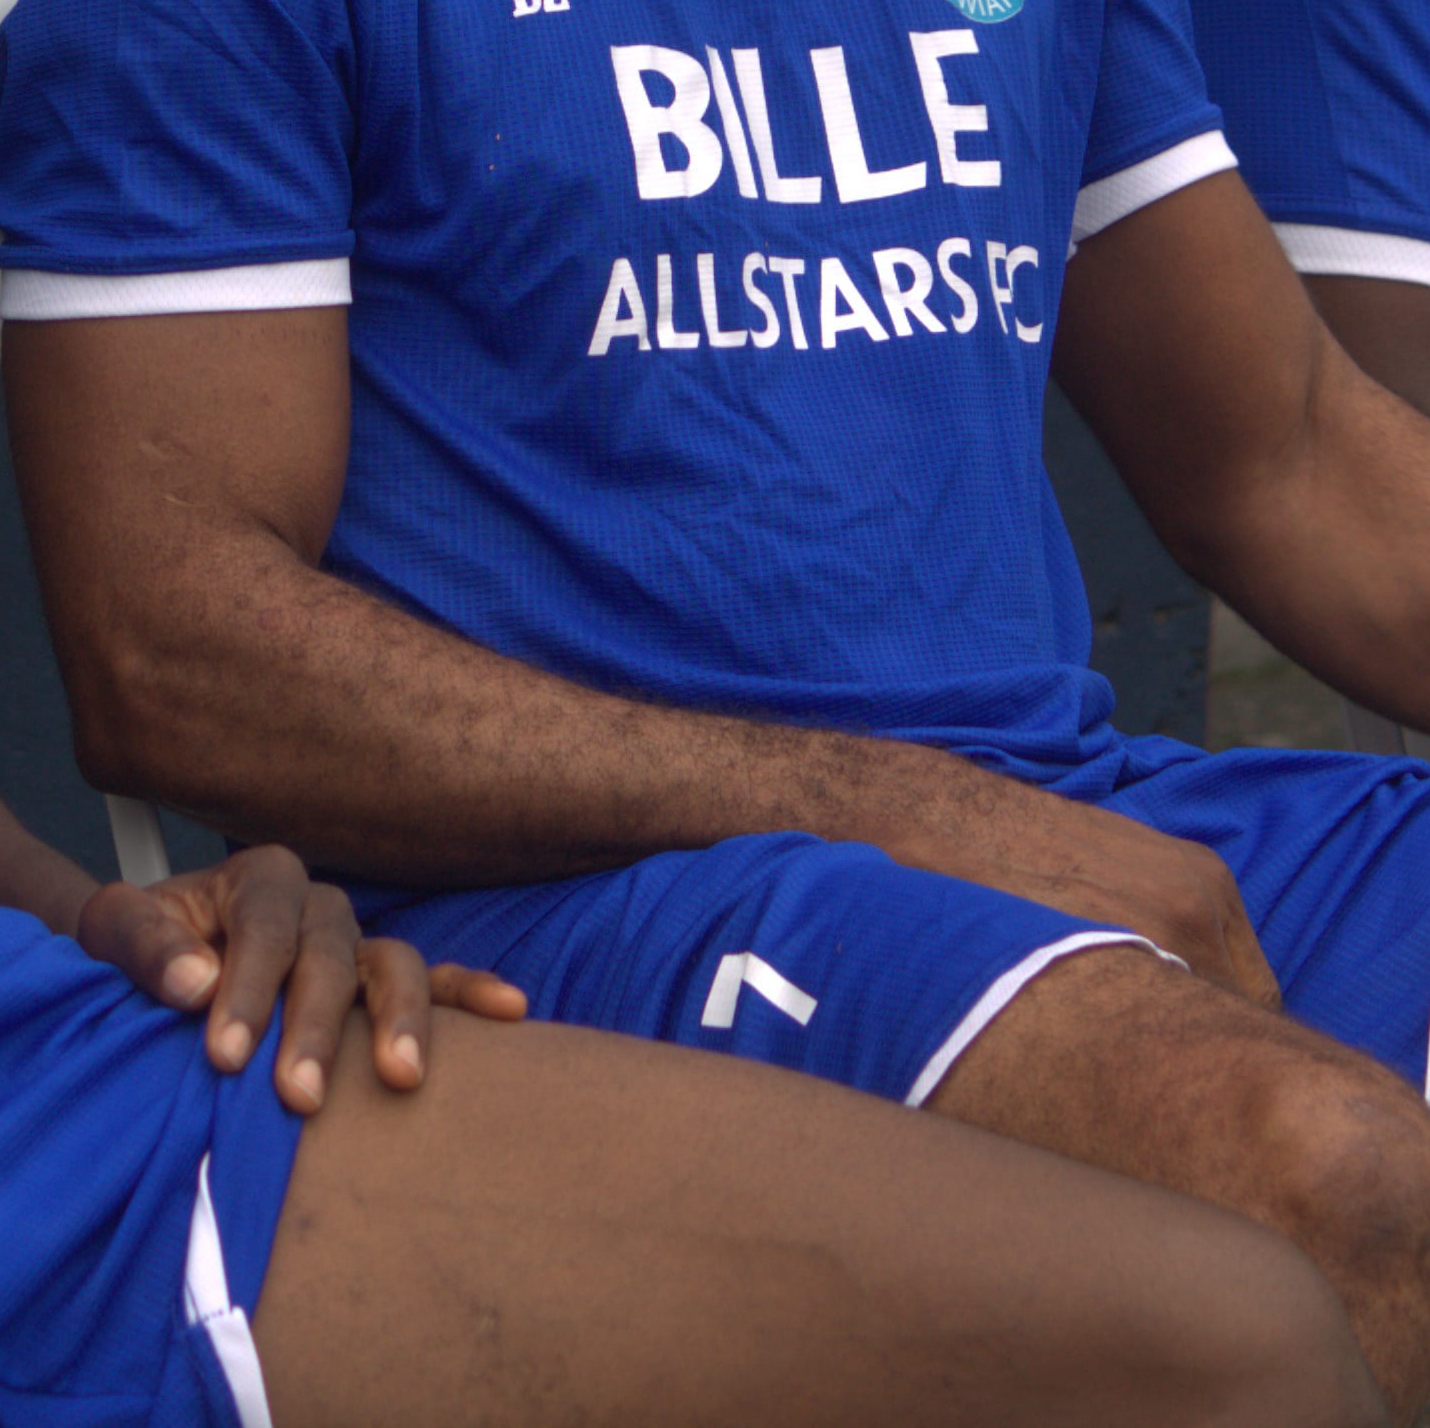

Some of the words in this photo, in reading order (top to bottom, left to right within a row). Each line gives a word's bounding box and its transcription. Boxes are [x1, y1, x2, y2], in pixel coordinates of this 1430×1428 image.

[610, 29, 1002, 205] BILLE
[587, 237, 979, 357] ALLSTARS
[986, 240, 1043, 344] FC
[701, 952, 818, 1029] 7
